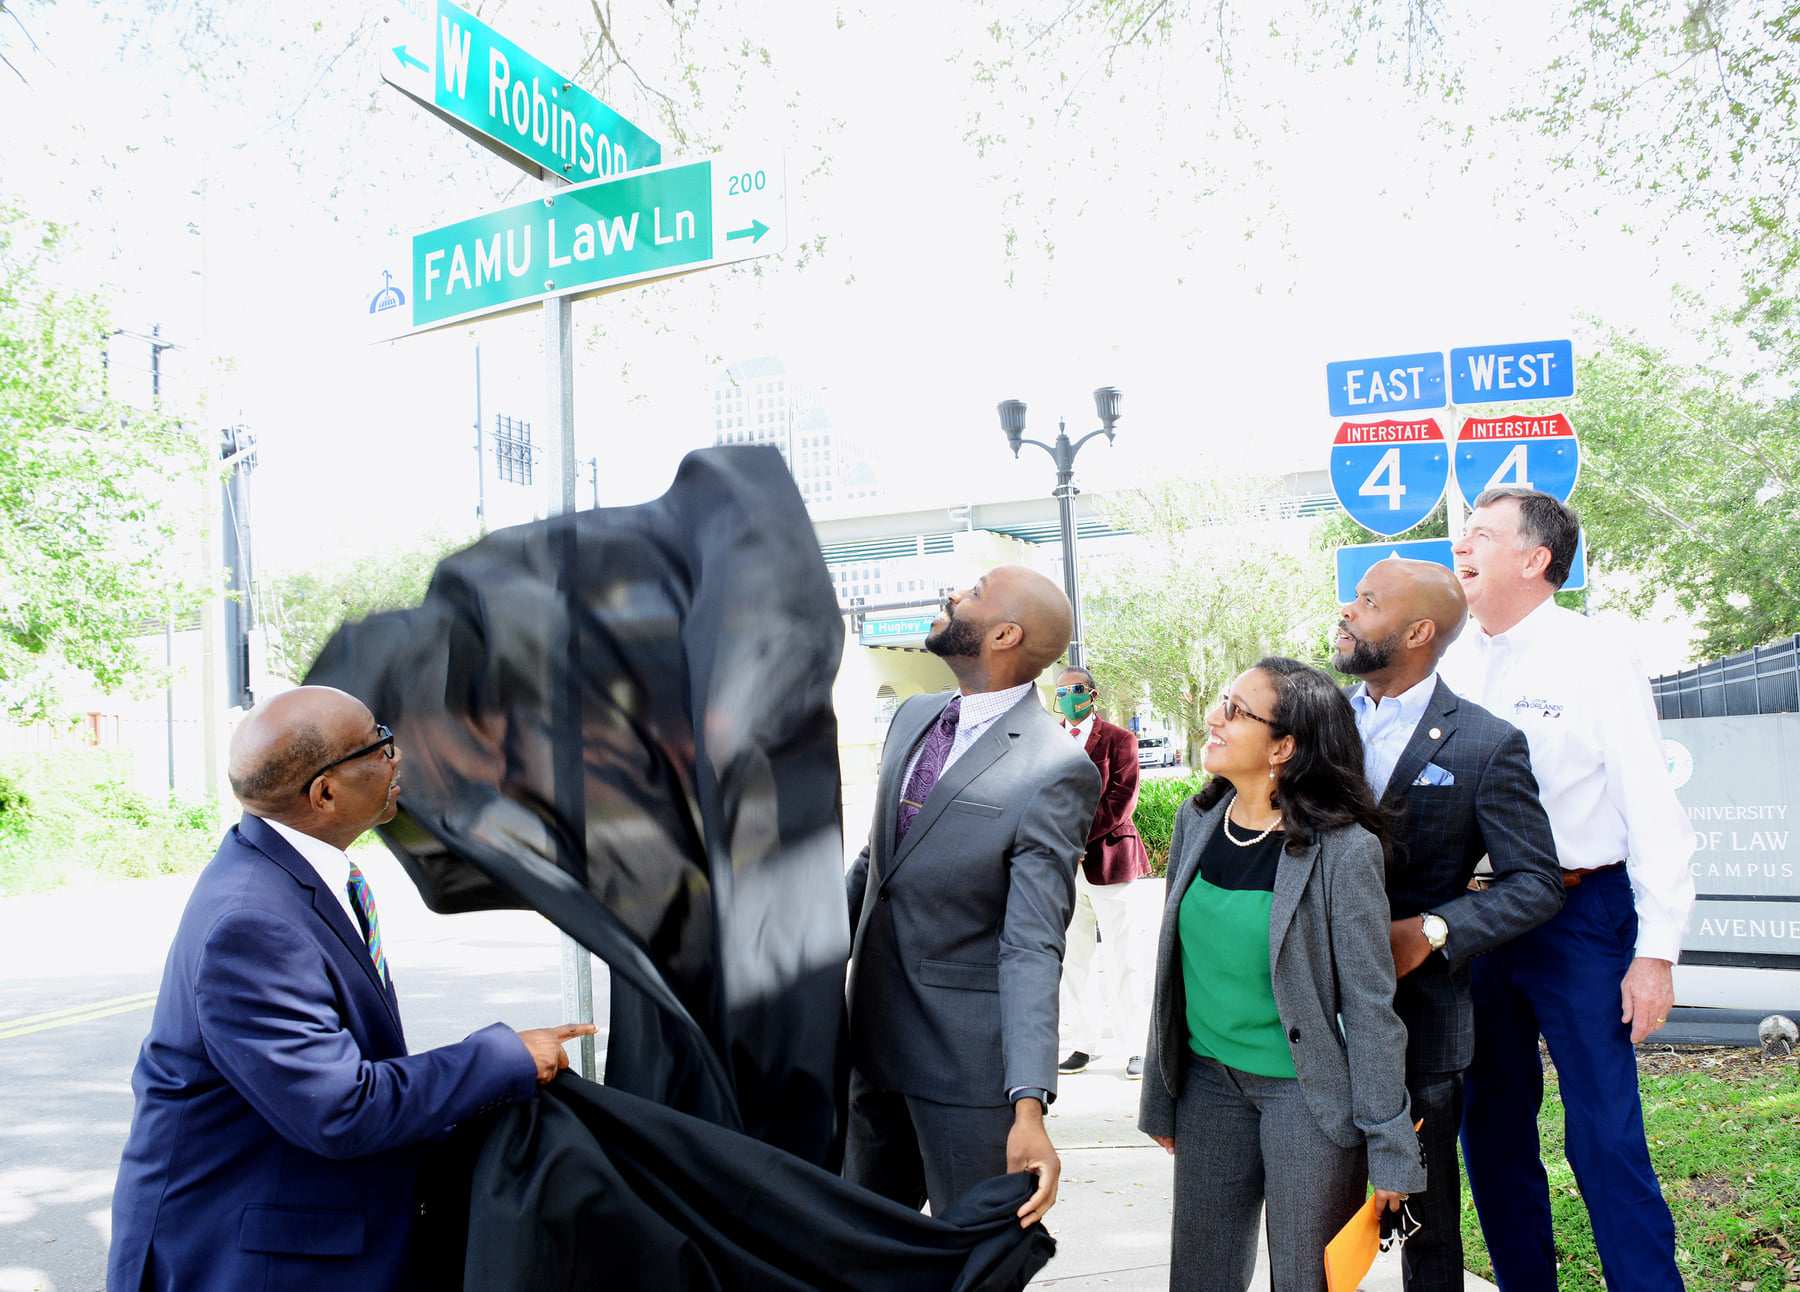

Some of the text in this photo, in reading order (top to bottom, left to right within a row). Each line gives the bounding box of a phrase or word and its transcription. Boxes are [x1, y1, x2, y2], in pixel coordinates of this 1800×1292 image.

[441, 15, 628, 176] W Robinson
[728, 170, 766, 196] 200
[424, 206, 695, 301] FAMU Law Ln
[1468, 352, 1555, 392] WEST
[1346, 367, 1425, 406] EAST
[1347, 423, 1430, 442] INTERSTATE
[1472, 420, 1558, 438] INTERSTATE
[1484, 444, 1534, 489] 4
[1358, 447, 1407, 511] 4
[879, 621, 920, 634] Hughey
[1530, 702, 1564, 711] ORLANDO
[1695, 831, 1789, 851] OF LAW
[1690, 863, 1793, 878] CAMPUS
[1699, 918, 1800, 939] AVENUE
